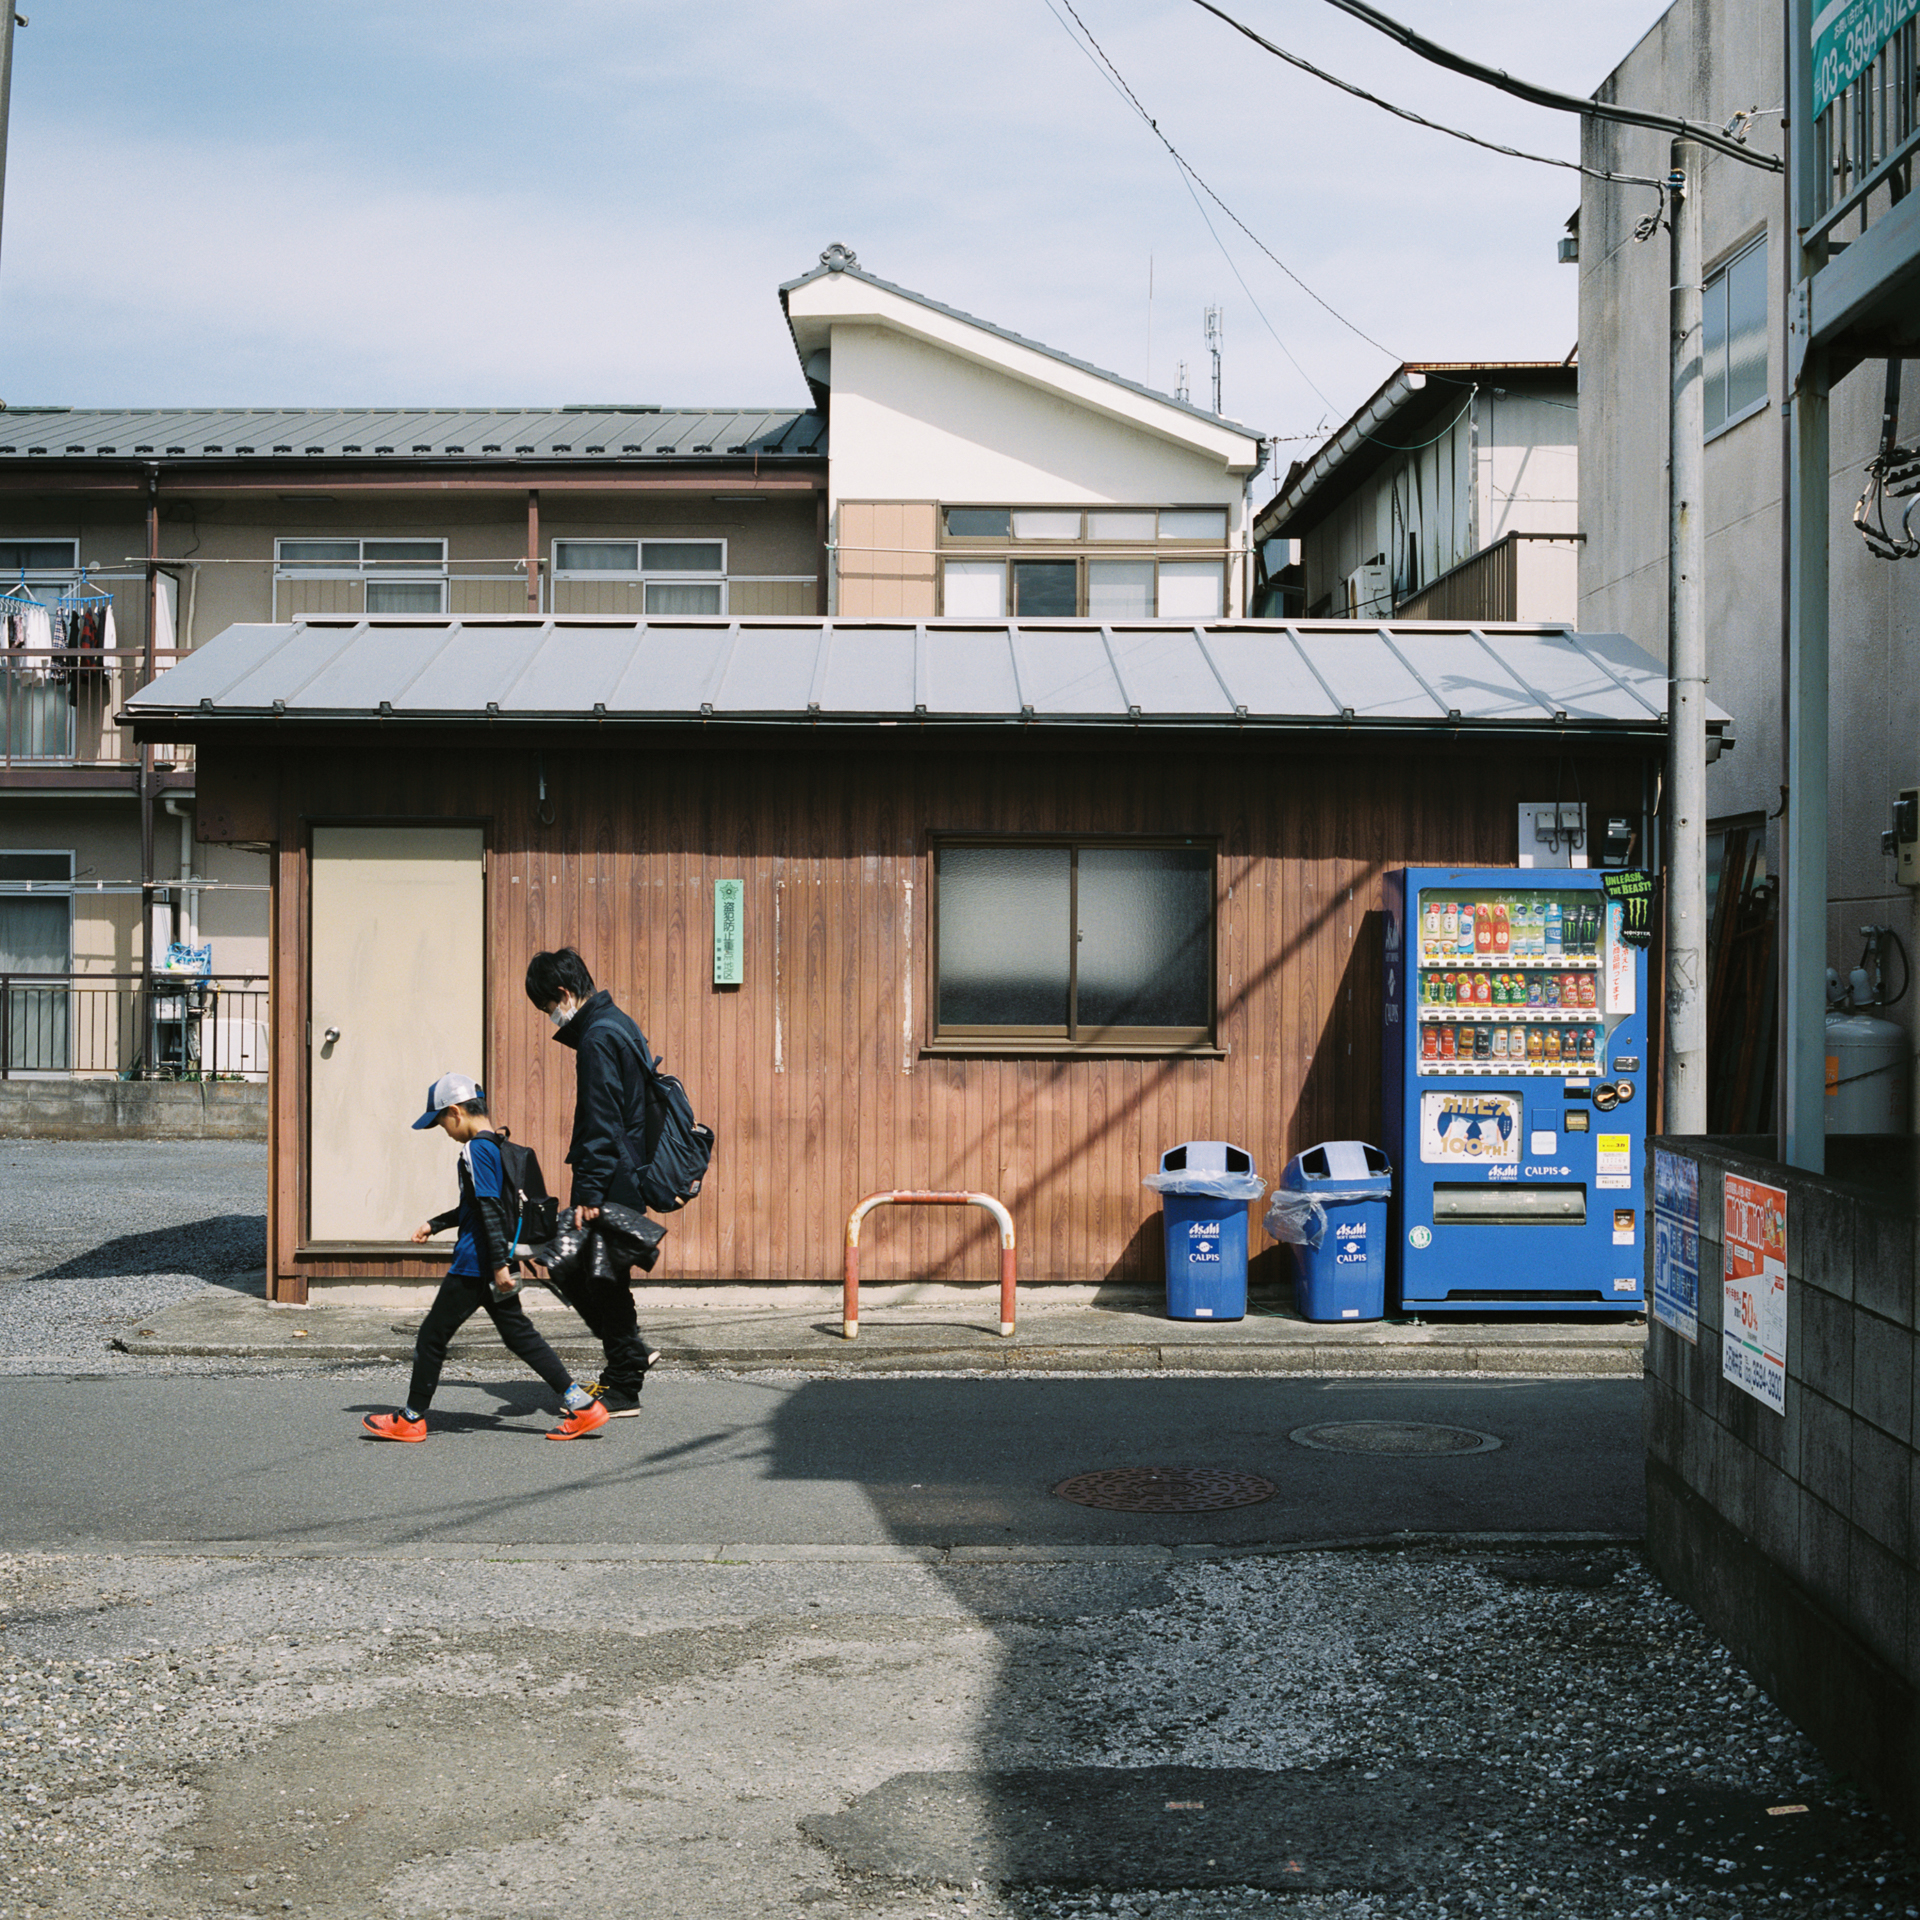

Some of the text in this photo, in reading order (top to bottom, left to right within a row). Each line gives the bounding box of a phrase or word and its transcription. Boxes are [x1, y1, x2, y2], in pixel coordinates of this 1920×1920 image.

[1609, 881, 1652, 896] THE BEAST!
[1443, 1097, 1511, 1116] カルピス
[1488, 1165, 1558, 1177] Asahi CALPIS
[1189, 1222, 1220, 1235] Asahi
[1336, 1222, 1367, 1235] Asahi
[1189, 1253, 1220, 1264] CALPIS
[1336, 1253, 1367, 1264] CALPIS
